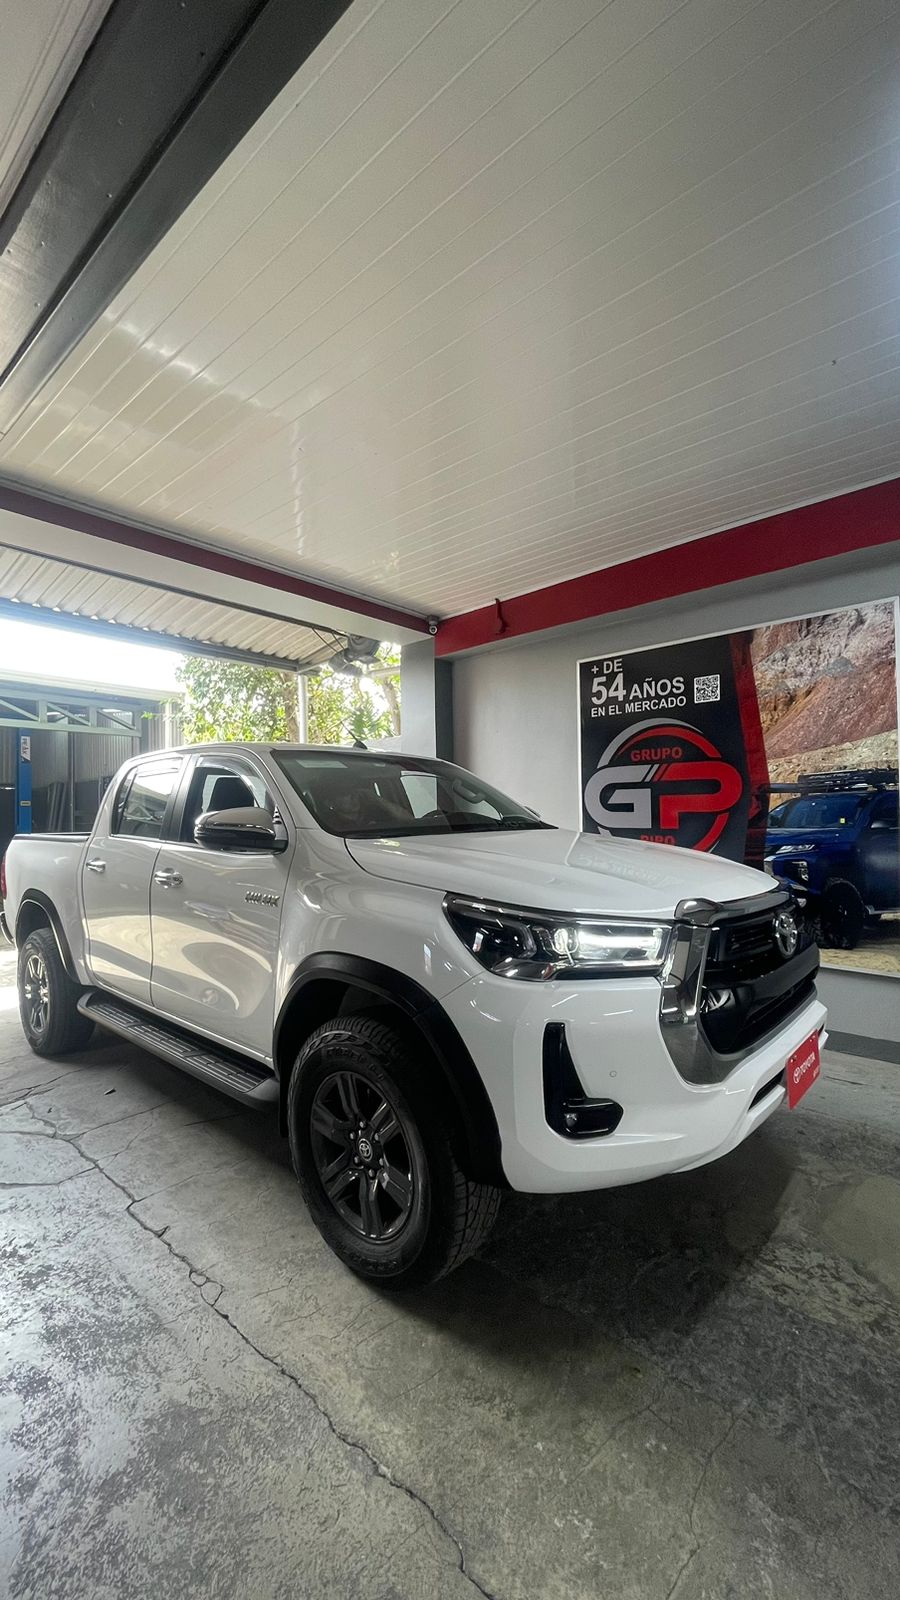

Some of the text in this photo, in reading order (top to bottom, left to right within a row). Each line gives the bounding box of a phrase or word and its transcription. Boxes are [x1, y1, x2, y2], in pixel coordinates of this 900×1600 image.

[603, 658, 623, 674] DE
[591, 672, 685, 705] 54 AÑOS
[591, 695, 687, 718] EN EL MERCADO
[630, 747, 683, 762] GRUPO
[584, 761, 743, 829] GP
